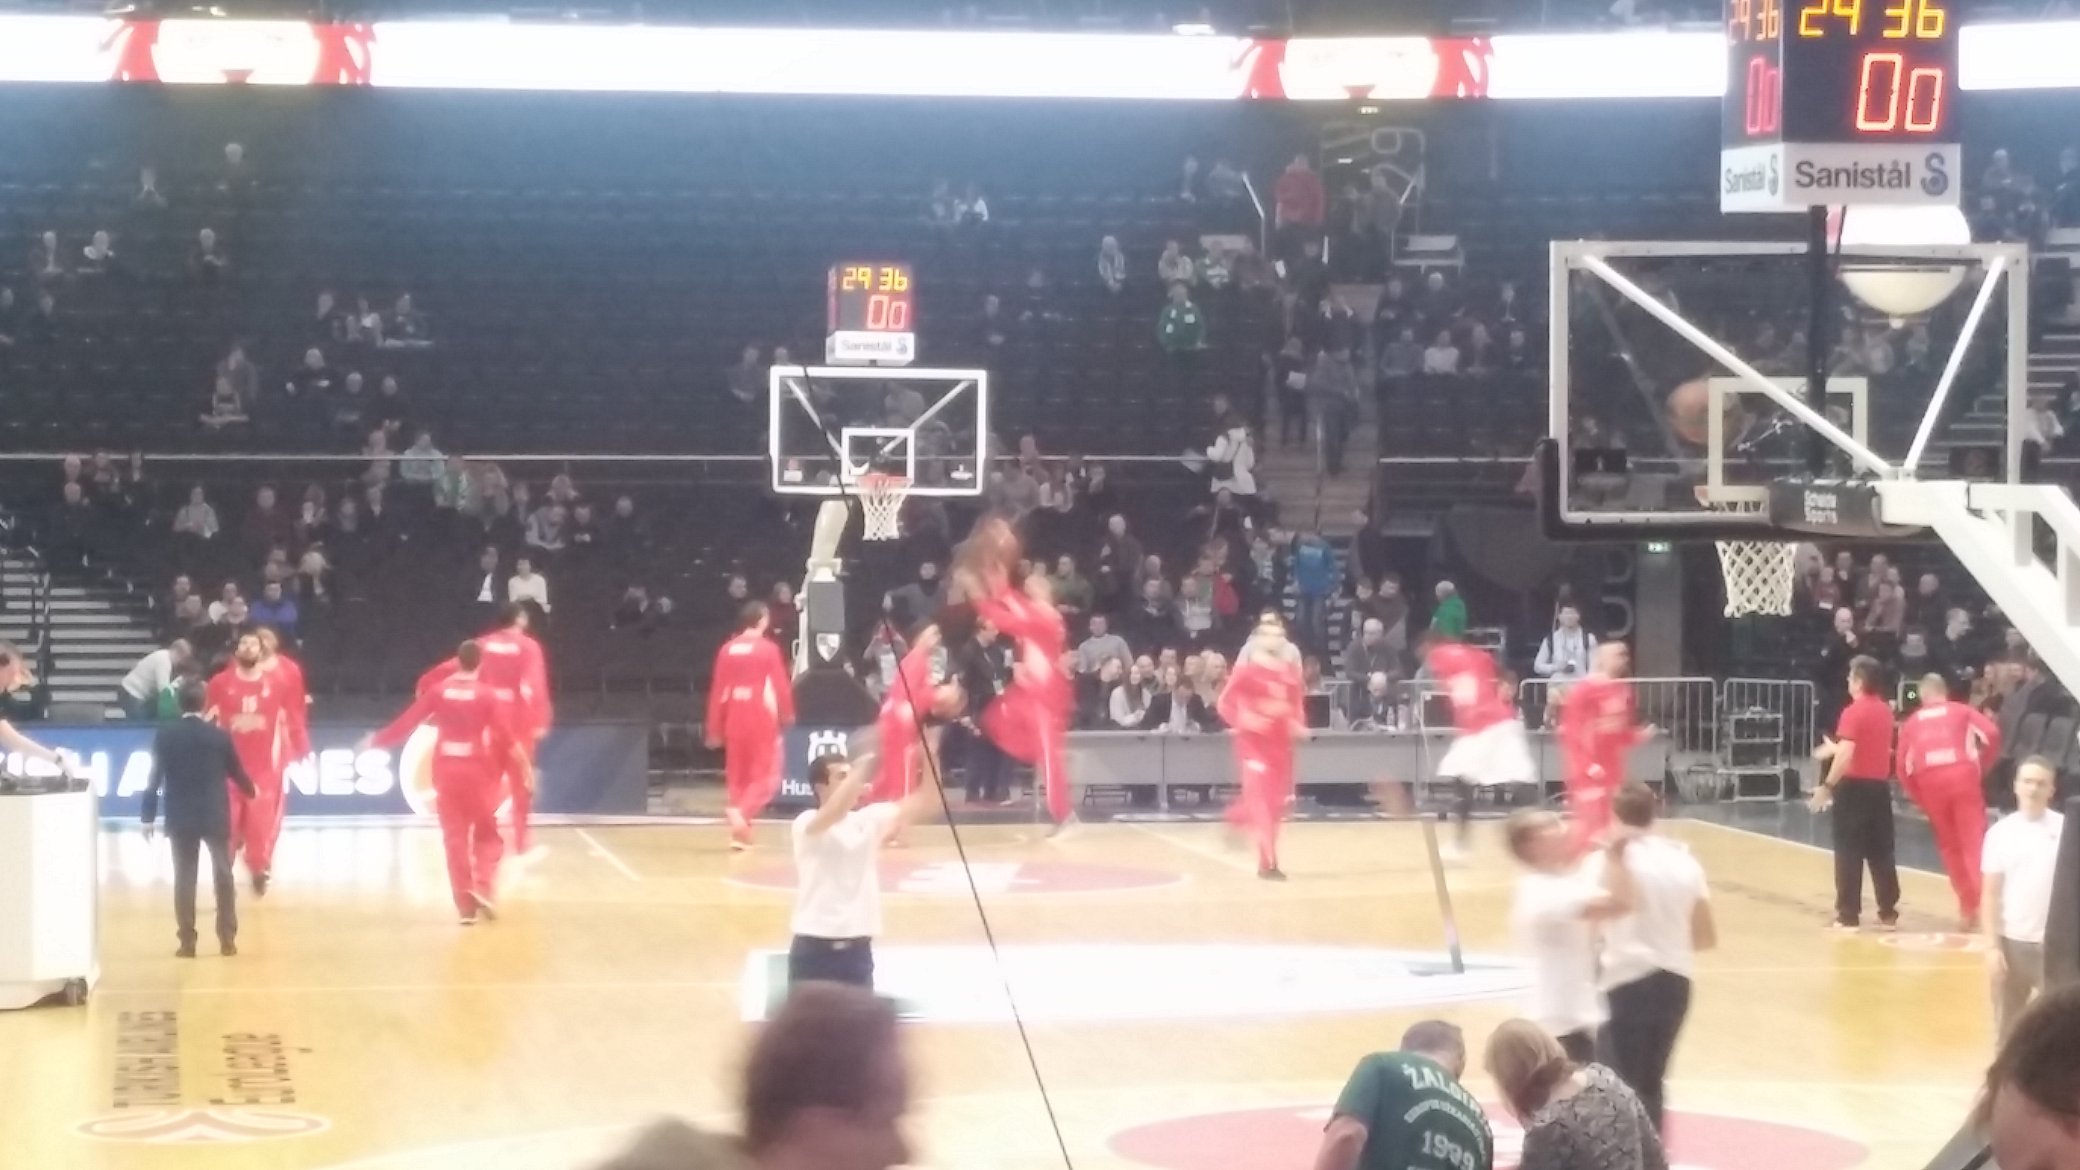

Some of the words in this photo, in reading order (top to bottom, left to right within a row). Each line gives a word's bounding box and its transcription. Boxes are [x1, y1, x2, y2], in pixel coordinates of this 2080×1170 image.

[1882, 0, 1946, 38] 36
[1855, 52, 1944, 132] 00
[1795, 160, 1911, 189] Sanistål
[842, 266, 872, 290] 29
[878, 266, 908, 291] 36
[867, 295, 907, 329] 00
